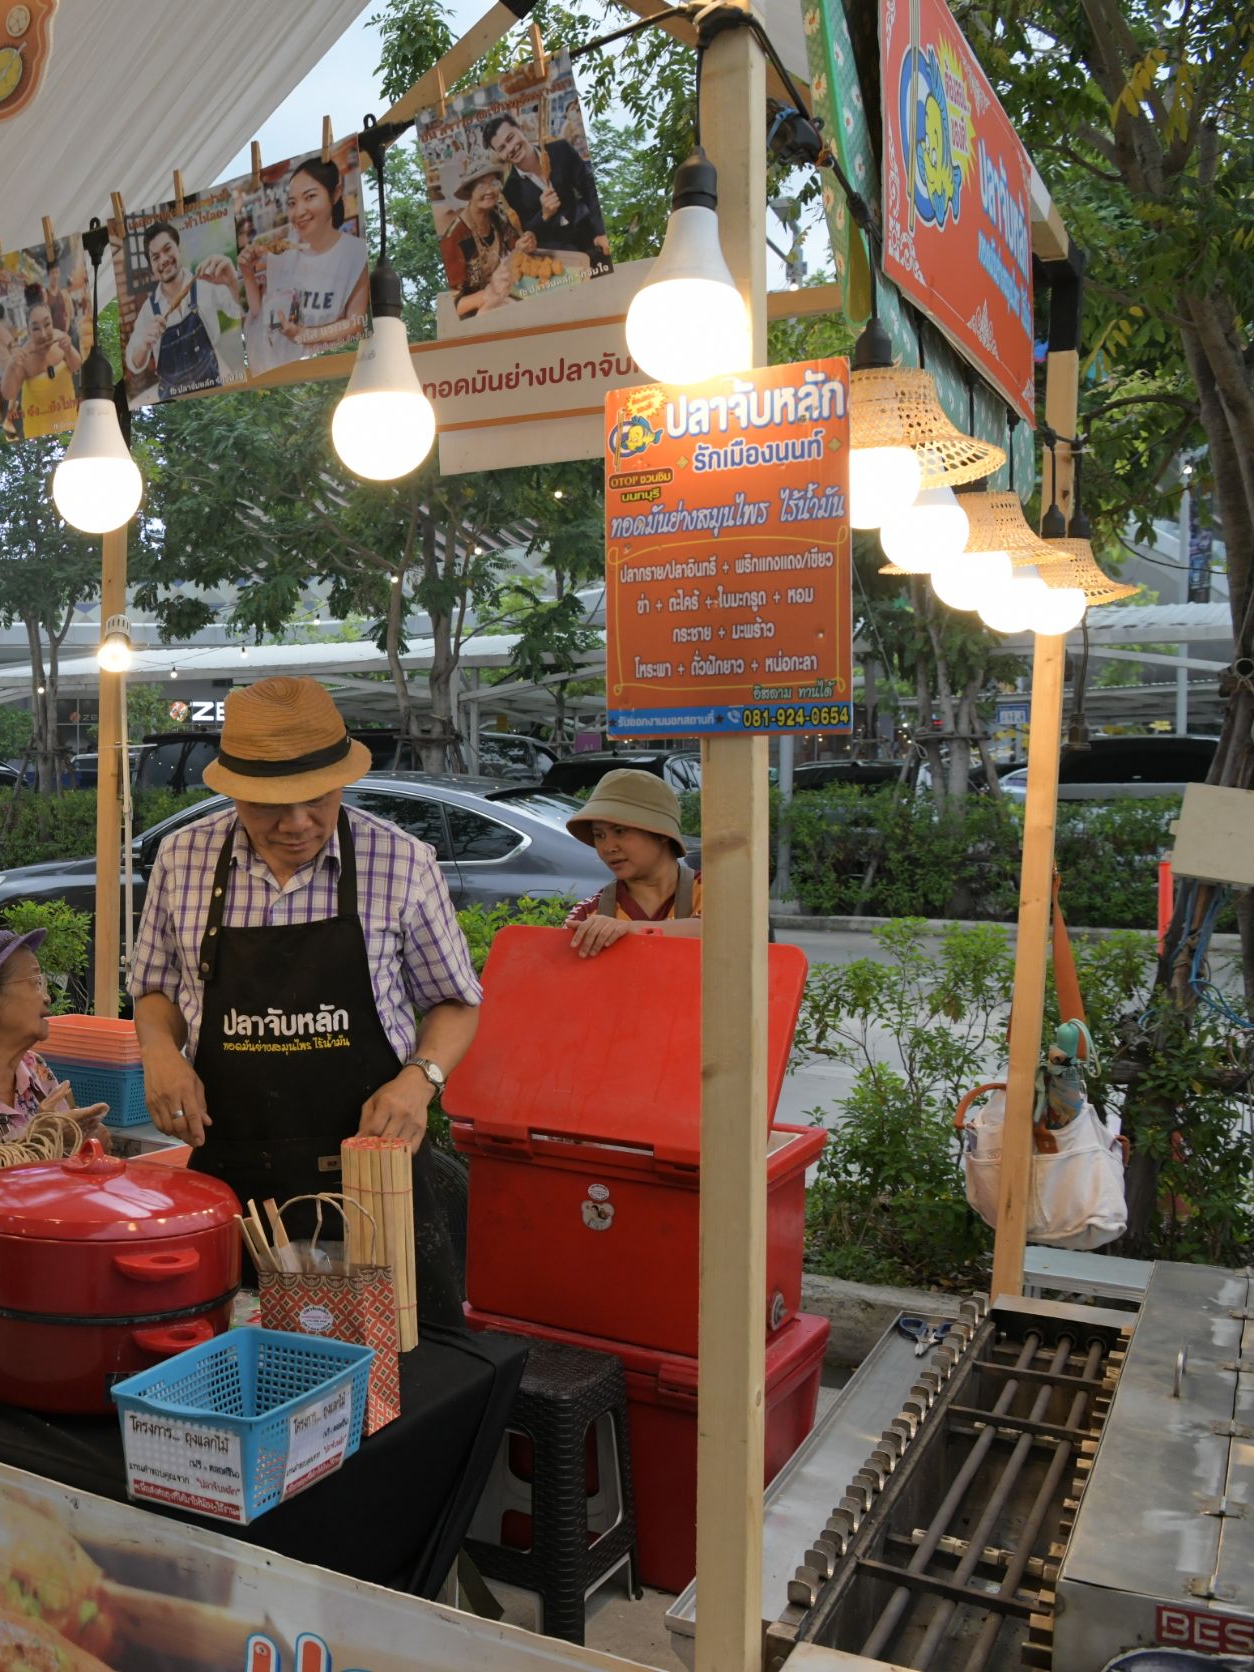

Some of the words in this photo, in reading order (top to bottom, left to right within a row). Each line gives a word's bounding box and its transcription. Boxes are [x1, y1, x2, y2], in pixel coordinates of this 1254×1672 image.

[299, 290, 334, 309] TLE
[666, 369, 845, 438] ปลาจับหลัก
[693, 430, 825, 472] รักเมืองนนท์
[610, 475, 638, 487] OTOP
[640, 471, 672, 485] ชวนชิม
[621, 487, 660, 502] นนทบุรี
[610, 492, 770, 540] ทอดมันย่างสมุนไพร
[779, 482, 845, 522] ไร้น้ำมัน
[619, 555, 718, 583] ปลากราย/ปลาอินทรี
[735, 547, 834, 574] พริกแกงแดง/เขียว
[637, 594, 650, 615] ข่า
[668, 588, 700, 612] ตะไคร้
[717, 585, 767, 612] ใบมะกรูด
[787, 586, 814, 604] หอม
[672, 625, 712, 643] กระชาย
[731, 616, 775, 640] มะพร้าว
[634, 655, 672, 679] โหระพา
[690, 650, 745, 676] ถั่วฝักยาว
[765, 650, 818, 672] หน่อกะลา
[192, 701, 226, 721] ZE
[742, 706, 849, 728] 081-924-0654
[223, 1003, 350, 1037] ปลาจับหลัก
[129, 1415, 181, 1442] โครงการ...
[185, 1431, 230, 1455] ถุงแลกไม้
